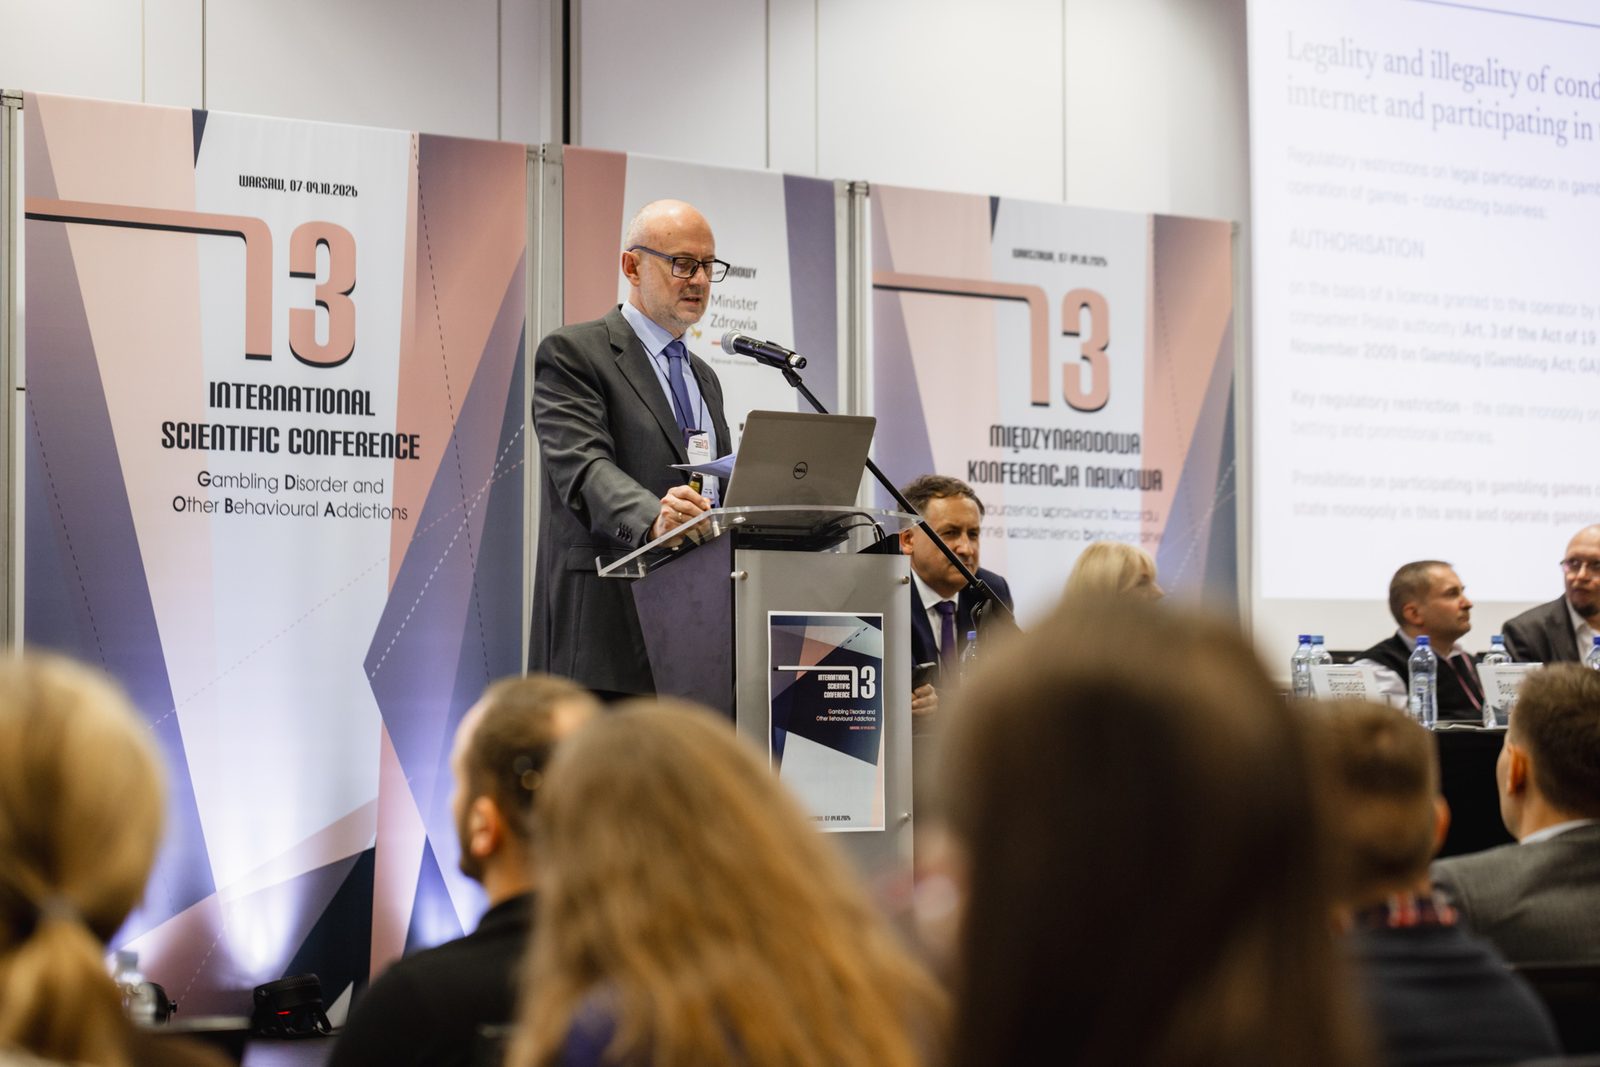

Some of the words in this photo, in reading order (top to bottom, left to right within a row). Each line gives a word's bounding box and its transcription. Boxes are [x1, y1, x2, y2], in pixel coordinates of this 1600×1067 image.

[1286, 30, 1378, 79] Legality
[1384, 48, 1424, 78] and
[1430, 49, 1521, 98] illegality
[1527, 65, 1551, 93] of
[1286, 74, 1378, 116] internet
[1385, 91, 1425, 121] and
[1431, 99, 1568, 147] participating
[1573, 111, 1593, 141] in
[239, 174, 287, 193] WARSAW,
[1289, 228, 1425, 259] AUTHORISATION
[710, 293, 758, 311] Minister
[710, 313, 758, 331] Zdrowia
[209, 381, 376, 417] INTERNATIONAL
[161, 421, 280, 454] SCIENTIFIC
[288, 427, 421, 460] CONFERENCE
[989, 424, 1141, 455] MIĘDZYNARODOWA
[197, 470, 279, 494] Gambling
[284, 474, 350, 493] Disorder
[353, 479, 384, 495] and
[967, 460, 1080, 487] KONFERENCJA
[1085, 466, 1163, 491] NAUKOWA
[172, 495, 219, 514] Other
[224, 497, 319, 518] Behavioural
[323, 501, 408, 520] Addictions
[823, 691, 850, 699] CONFERENCE
[850, 665, 876, 699] 13
[828, 708, 849, 716] Gambling
